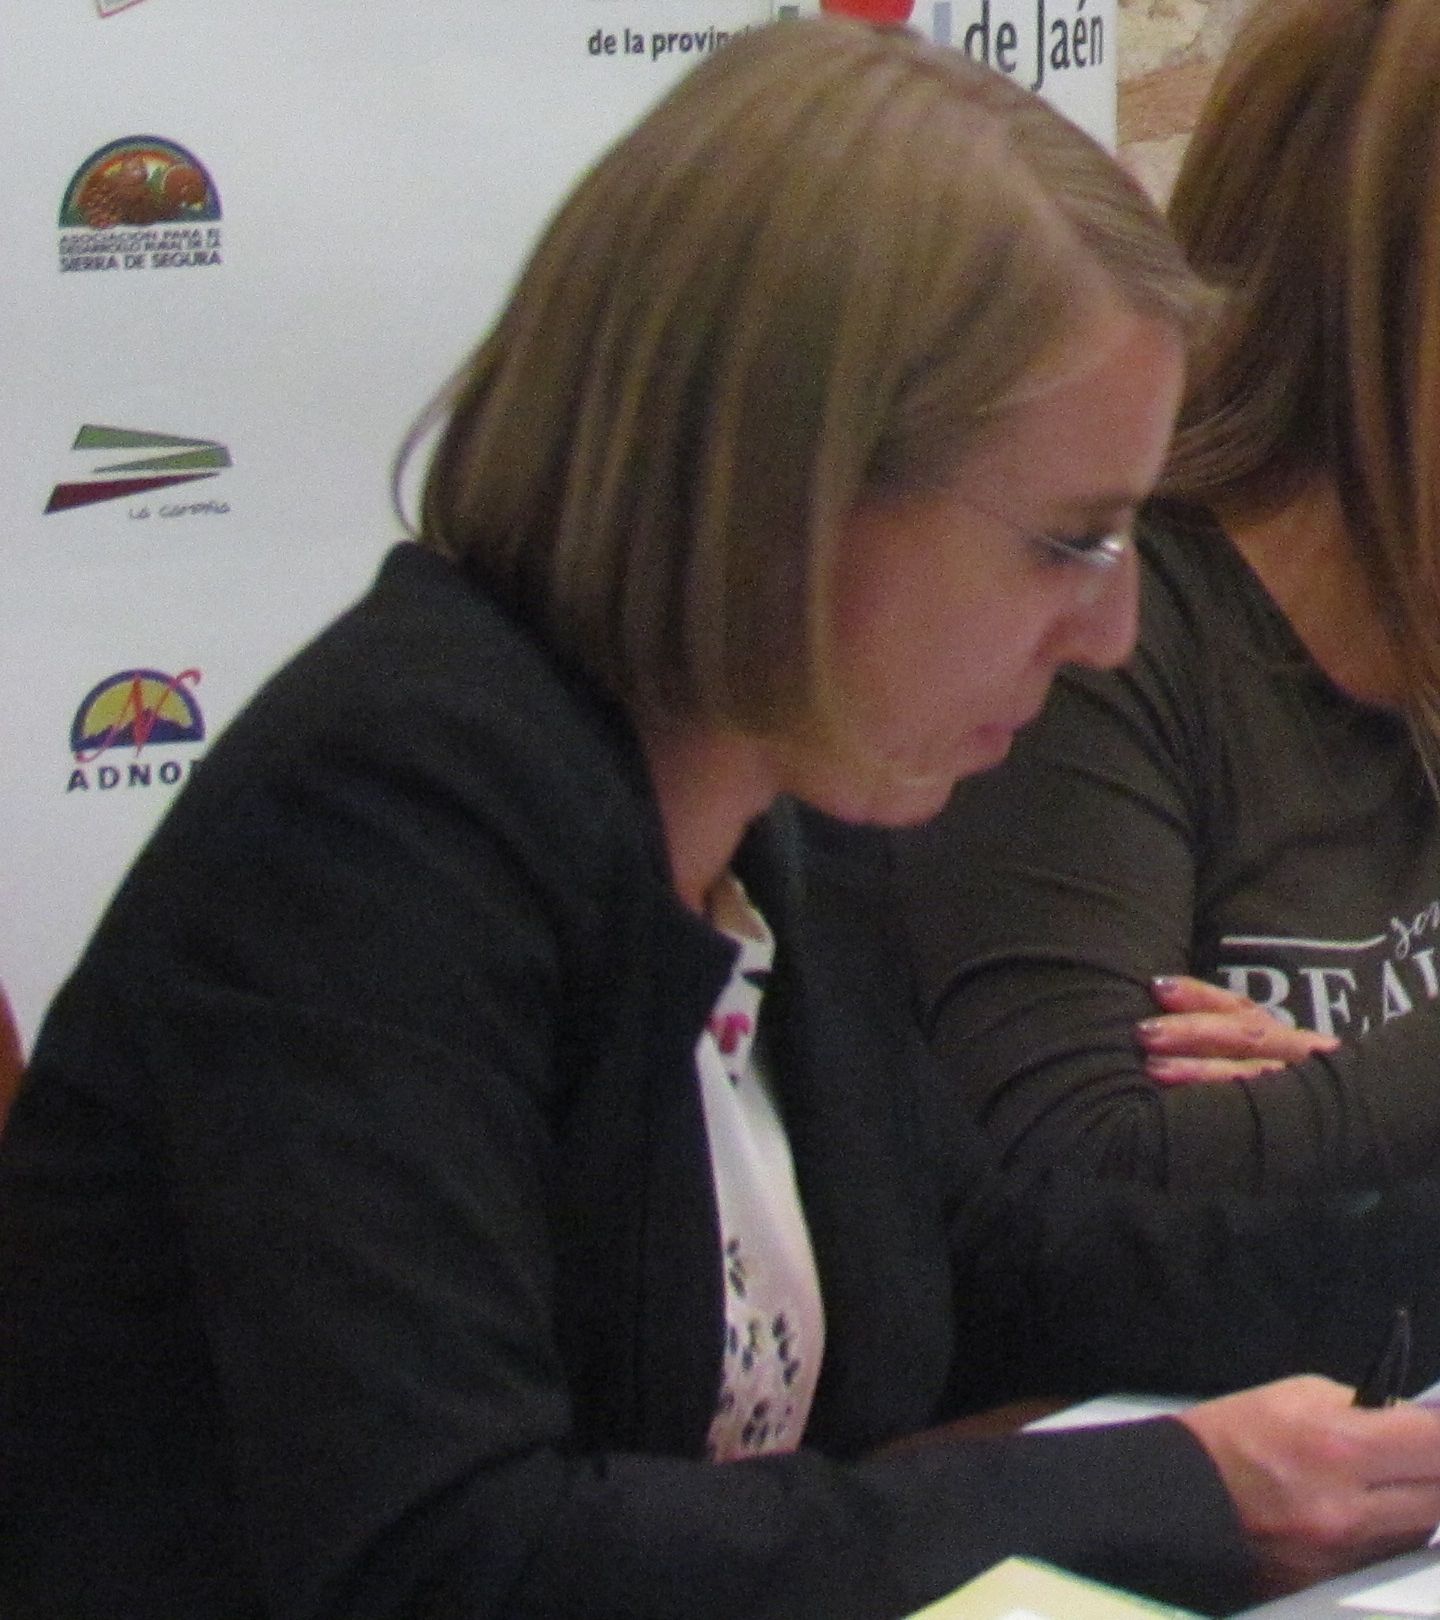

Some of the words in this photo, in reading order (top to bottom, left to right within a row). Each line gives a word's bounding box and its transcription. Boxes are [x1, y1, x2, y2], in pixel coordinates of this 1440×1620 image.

[588, 27, 618, 57] de
[623, 27, 646, 54] la
[963, 0, 1018, 74] de
[151, 250, 222, 268] SEGURA
[66, 759, 203, 793] ADNO
